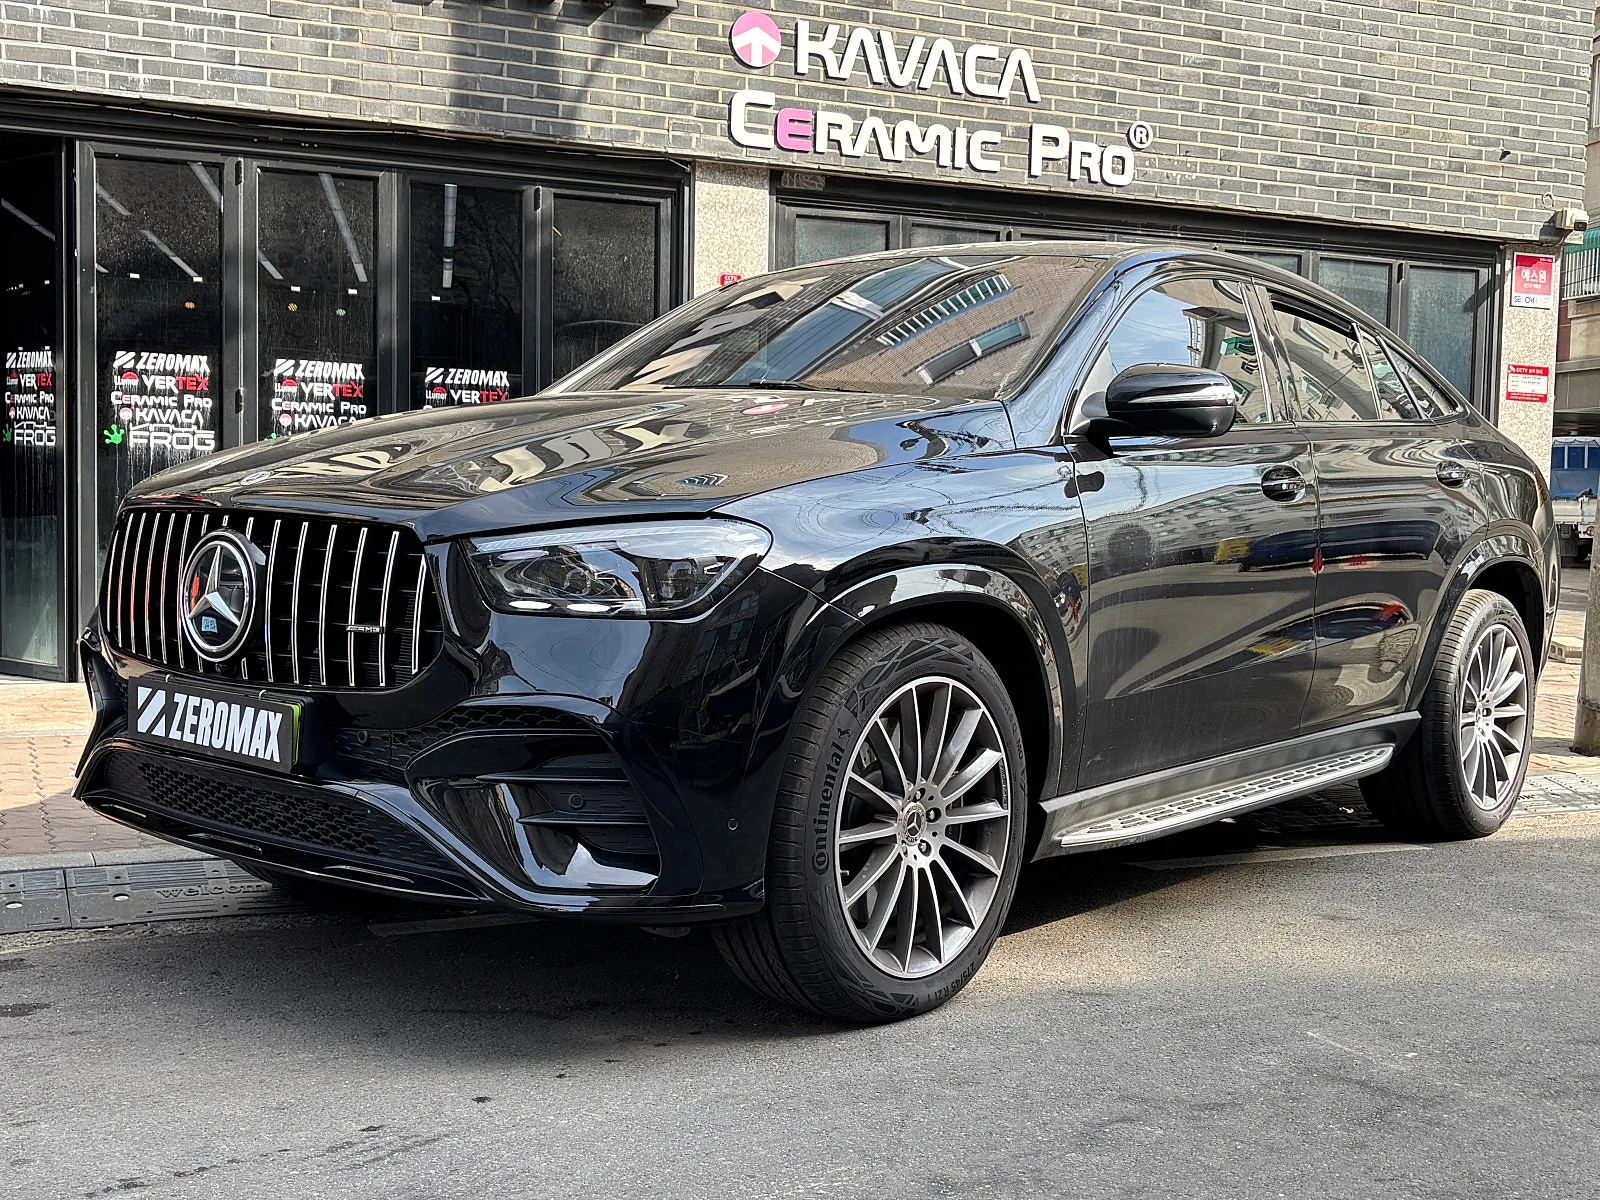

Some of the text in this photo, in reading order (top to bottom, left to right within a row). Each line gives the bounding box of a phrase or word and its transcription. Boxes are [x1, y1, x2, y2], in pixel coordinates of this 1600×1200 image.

[796, 20, 1041, 103] KAVACA
[16, 351, 53, 368] ZEROMAX
[136, 352, 210, 373] ZEROMAX
[295, 360, 365, 380] ZEROMAX
[445, 368, 510, 387] ZEROMAX
[19, 370, 52, 390] VERTEX
[142, 374, 209, 393] VERTEX
[301, 381, 364, 401] VERTEX
[16, 406, 50, 420] KAVACA
[136, 407, 204, 424] KAVACA
[14, 429, 56, 446] FROG
[130, 431, 215, 450] FROG
[169, 692, 283, 763] ZEROMAX
[812, 741, 847, 875] Continental
